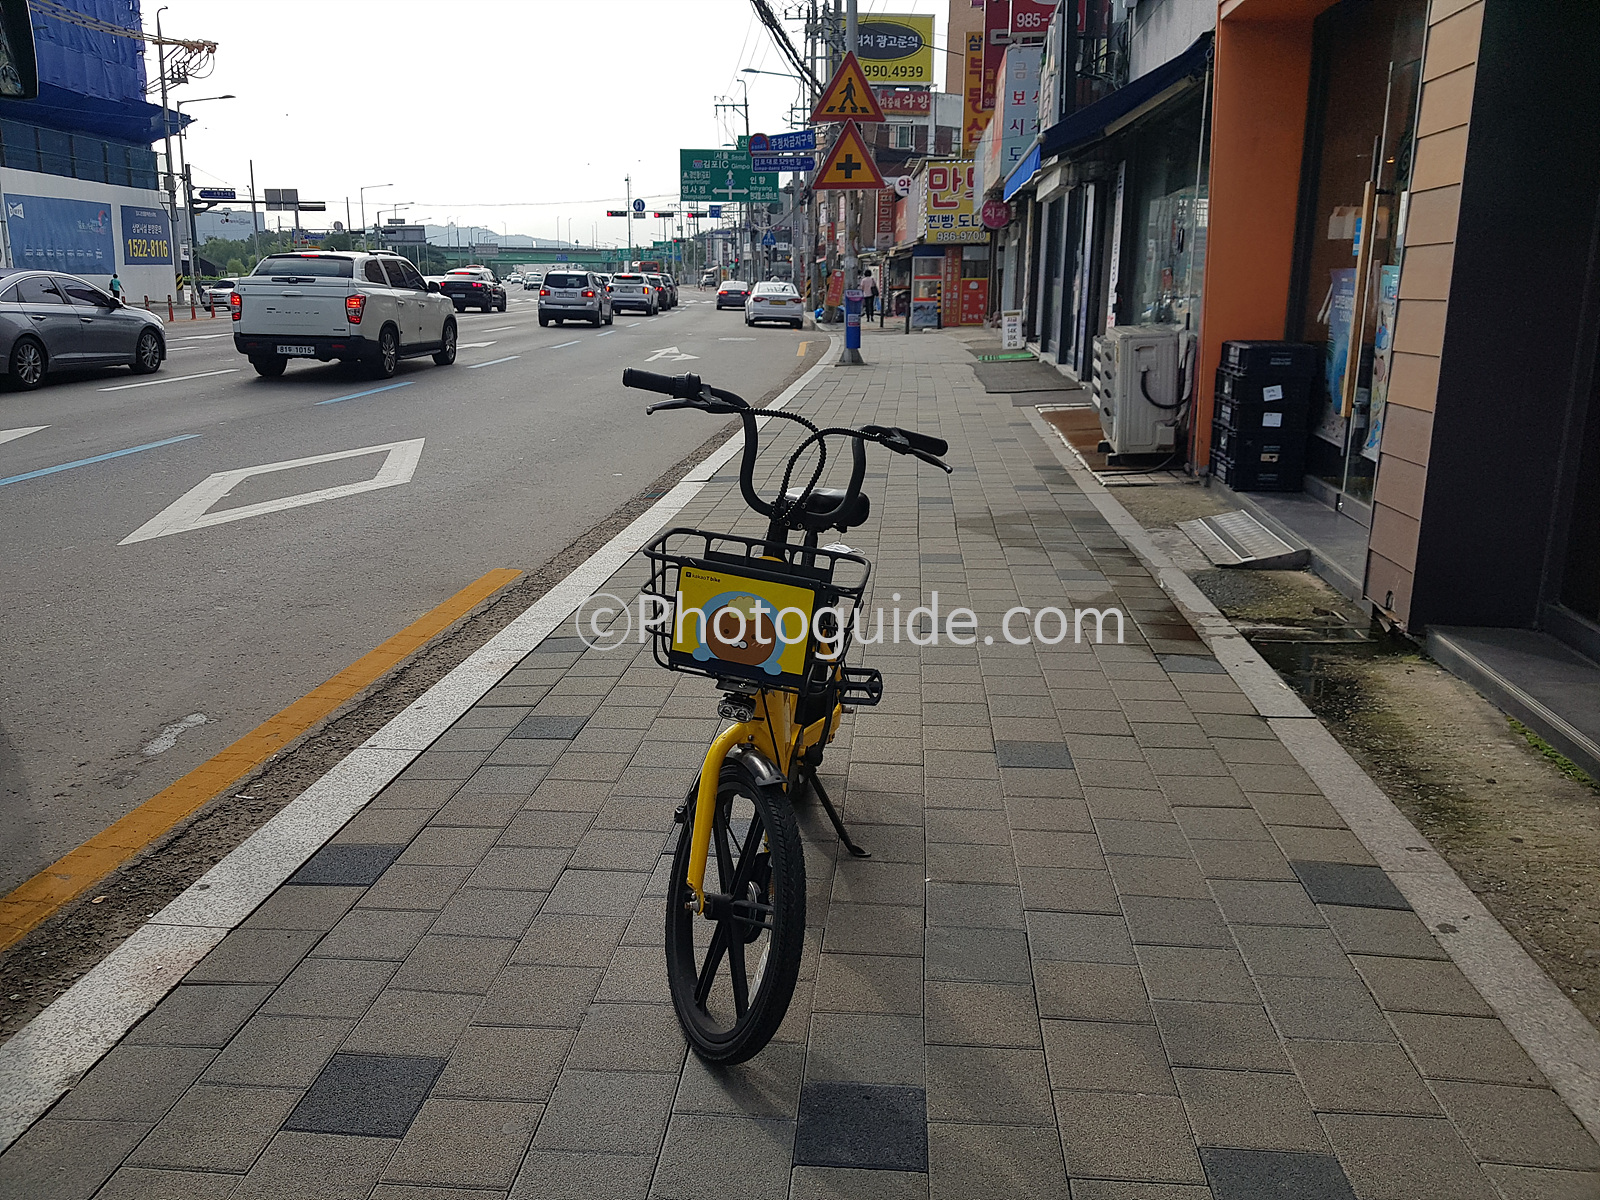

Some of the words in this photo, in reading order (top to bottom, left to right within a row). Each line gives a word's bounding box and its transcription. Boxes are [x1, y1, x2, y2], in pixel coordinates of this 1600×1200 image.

[876, 35, 918, 48] 광고문의
[864, 65, 924, 77] 990.4939
[771, 133, 813, 149] 주정차금지구역
[937, 231, 986, 241] 986-9700
[128, 239, 168, 257] 1522-8116
